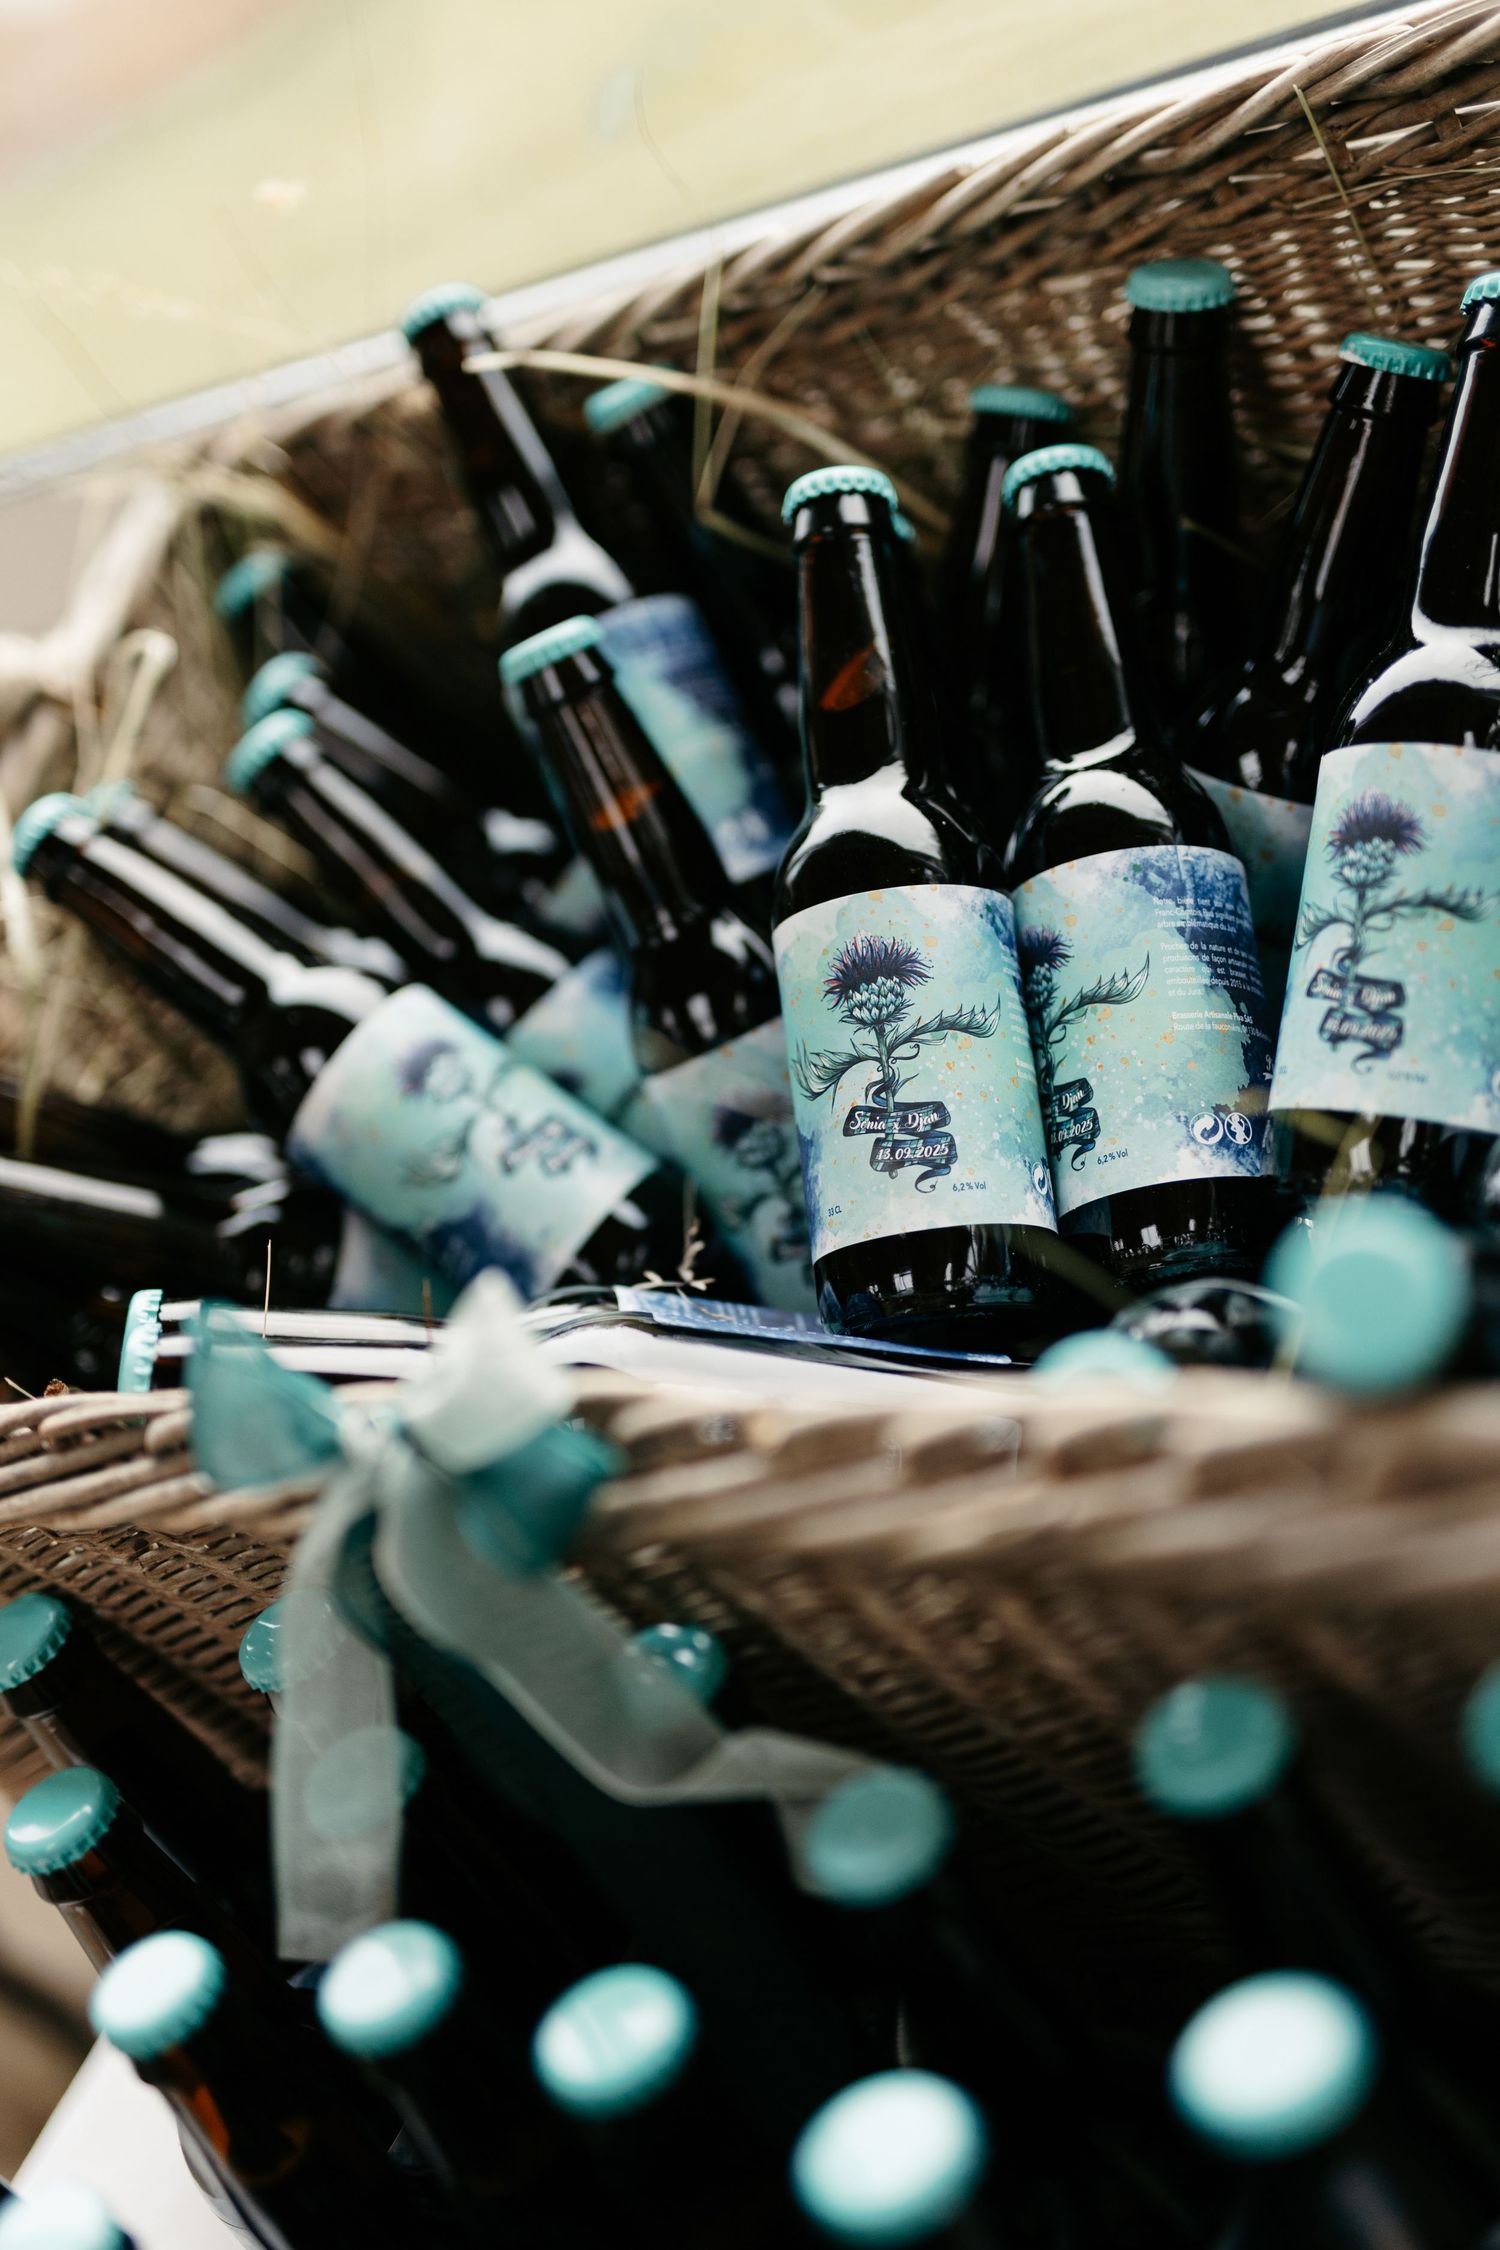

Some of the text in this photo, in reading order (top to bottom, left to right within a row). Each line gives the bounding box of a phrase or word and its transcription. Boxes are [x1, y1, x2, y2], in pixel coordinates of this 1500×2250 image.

[1189, 940, 1199, 951] de
[1200, 940, 1207, 951] la
[1201, 952, 1210, 962] de
[849, 1110, 940, 1132] Sonia x Djan
[876, 1142, 949, 1161] 13.09.2025
[1115, 1147, 1129, 1159] Vol
[974, 1180, 987, 1191] Vol
